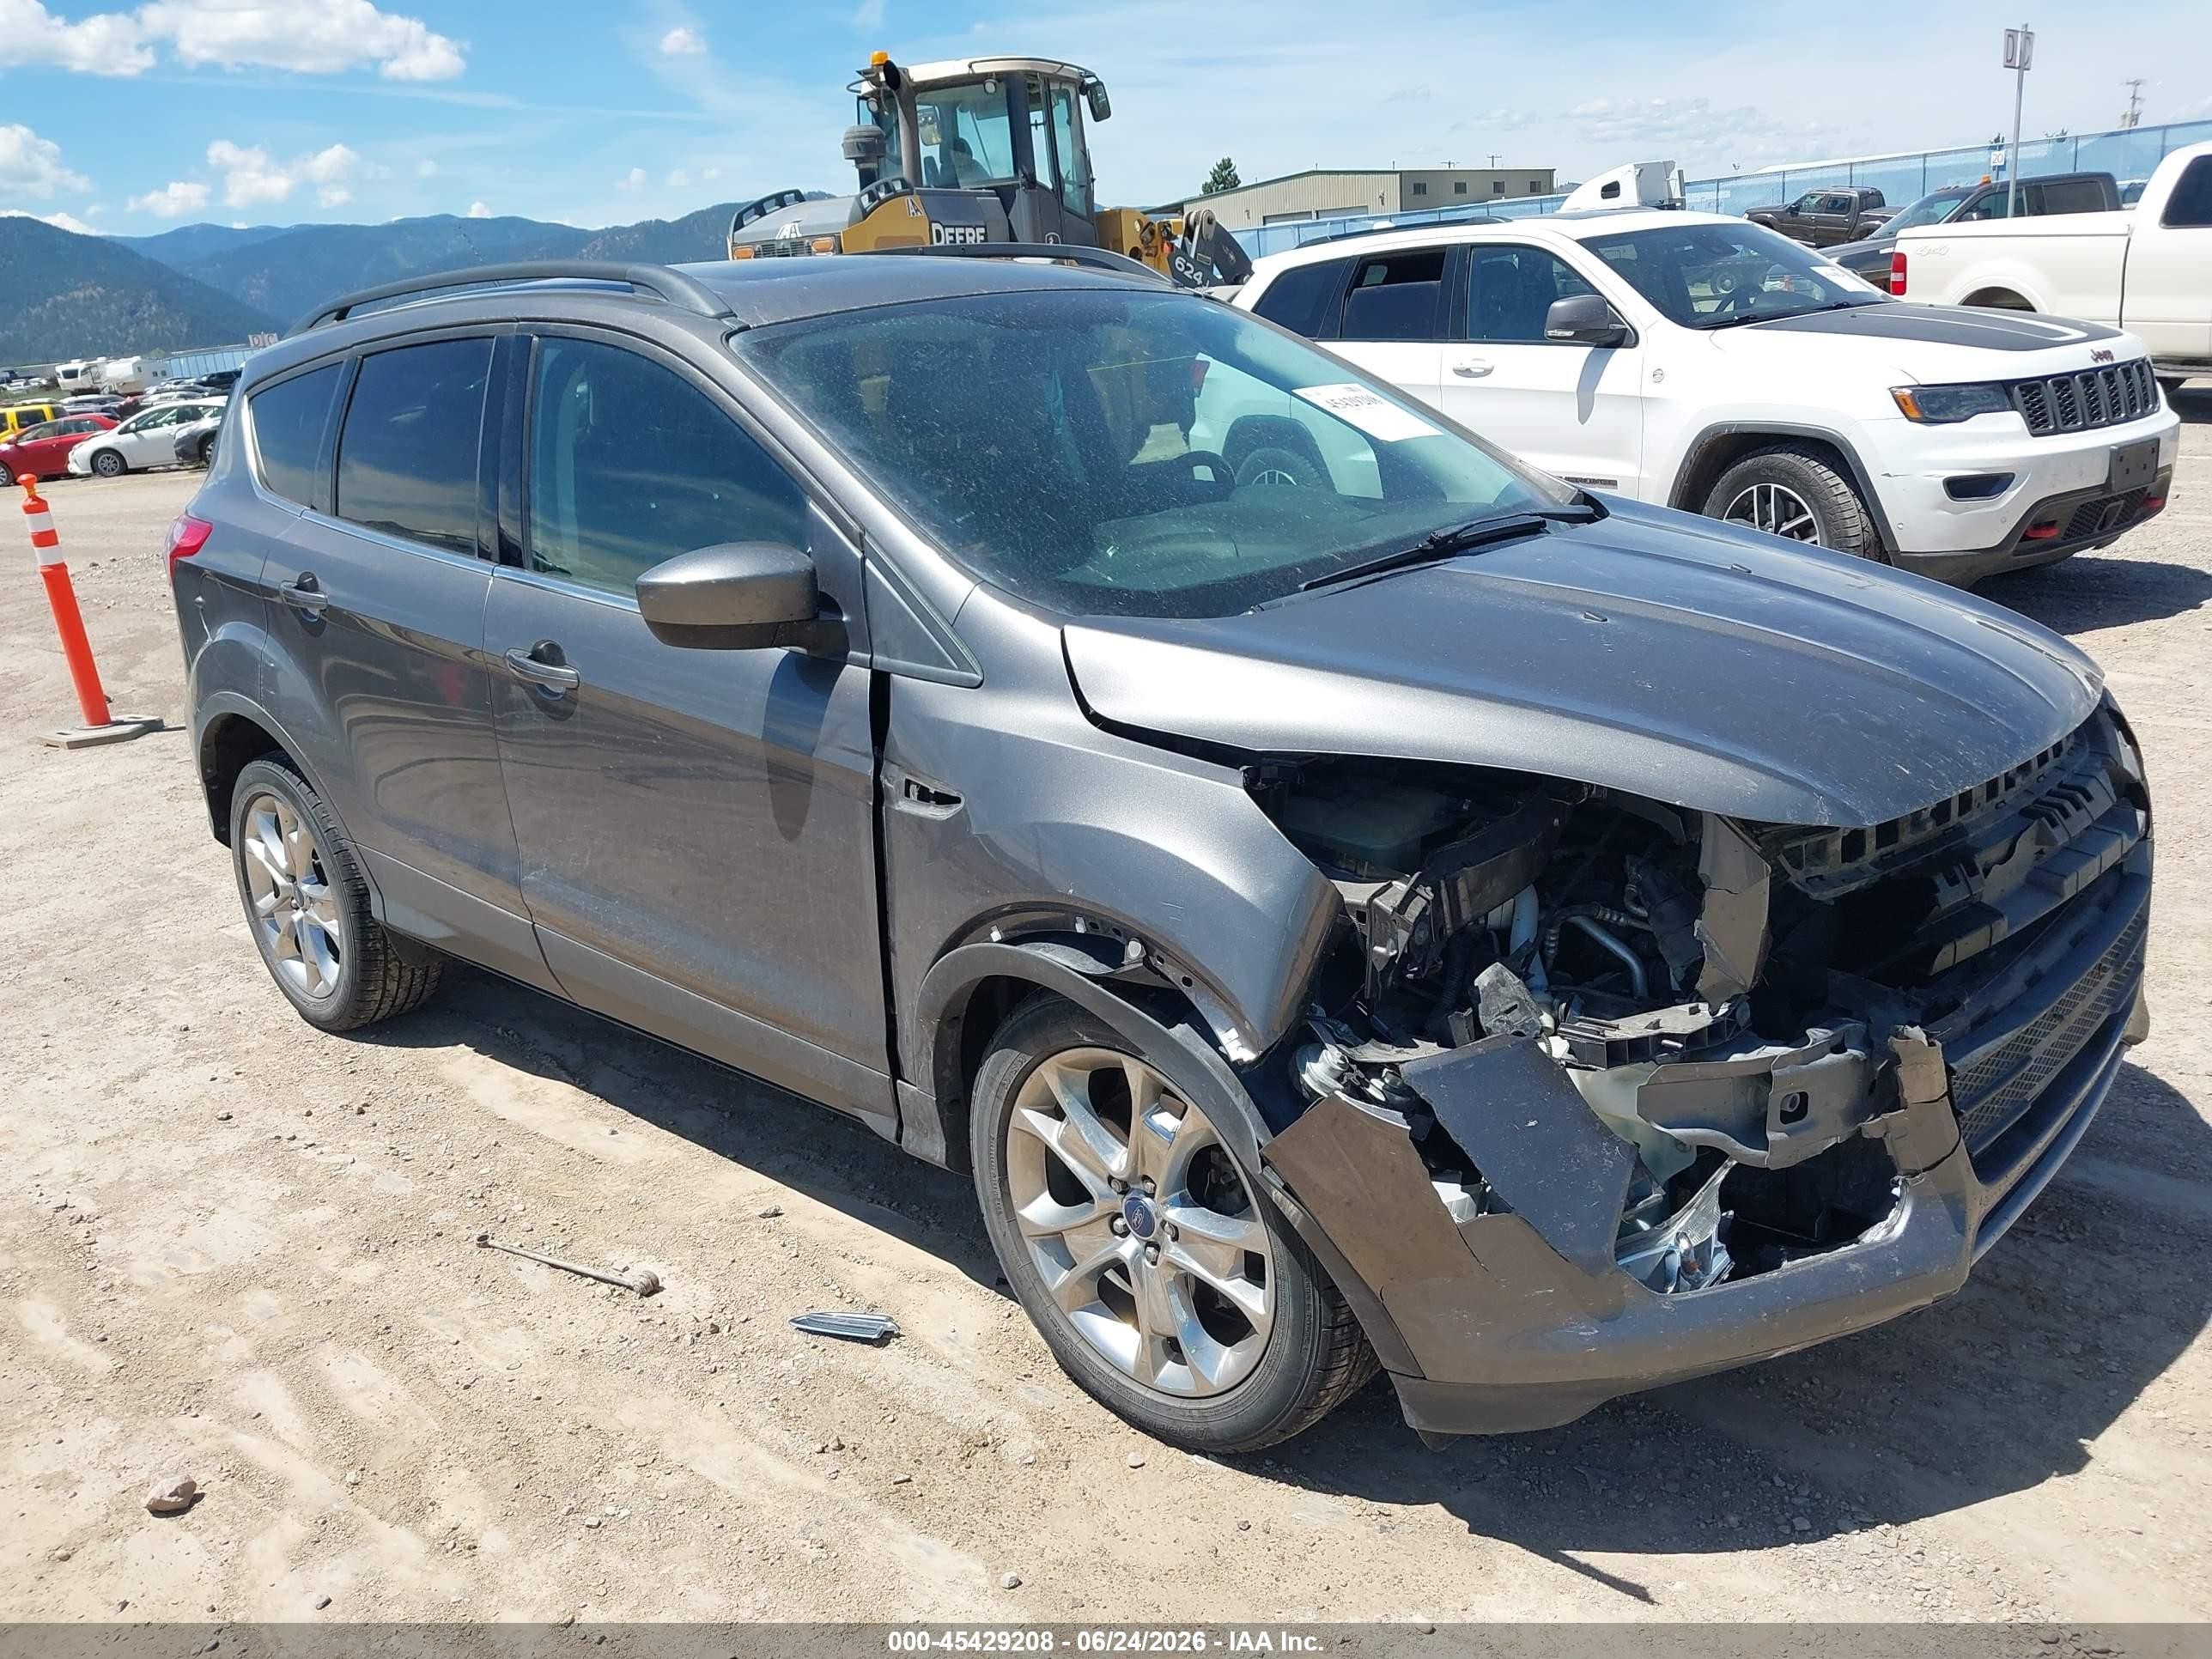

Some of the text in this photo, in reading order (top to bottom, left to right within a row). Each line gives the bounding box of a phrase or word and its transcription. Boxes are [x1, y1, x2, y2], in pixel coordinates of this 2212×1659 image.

[2006, 34, 2014, 63] D
[1992, 153, 2003, 163] 20
[932, 222, 985, 246] DEERE
[252, 336, 261, 347] D
[2090, 349, 2115, 363] Jeep
